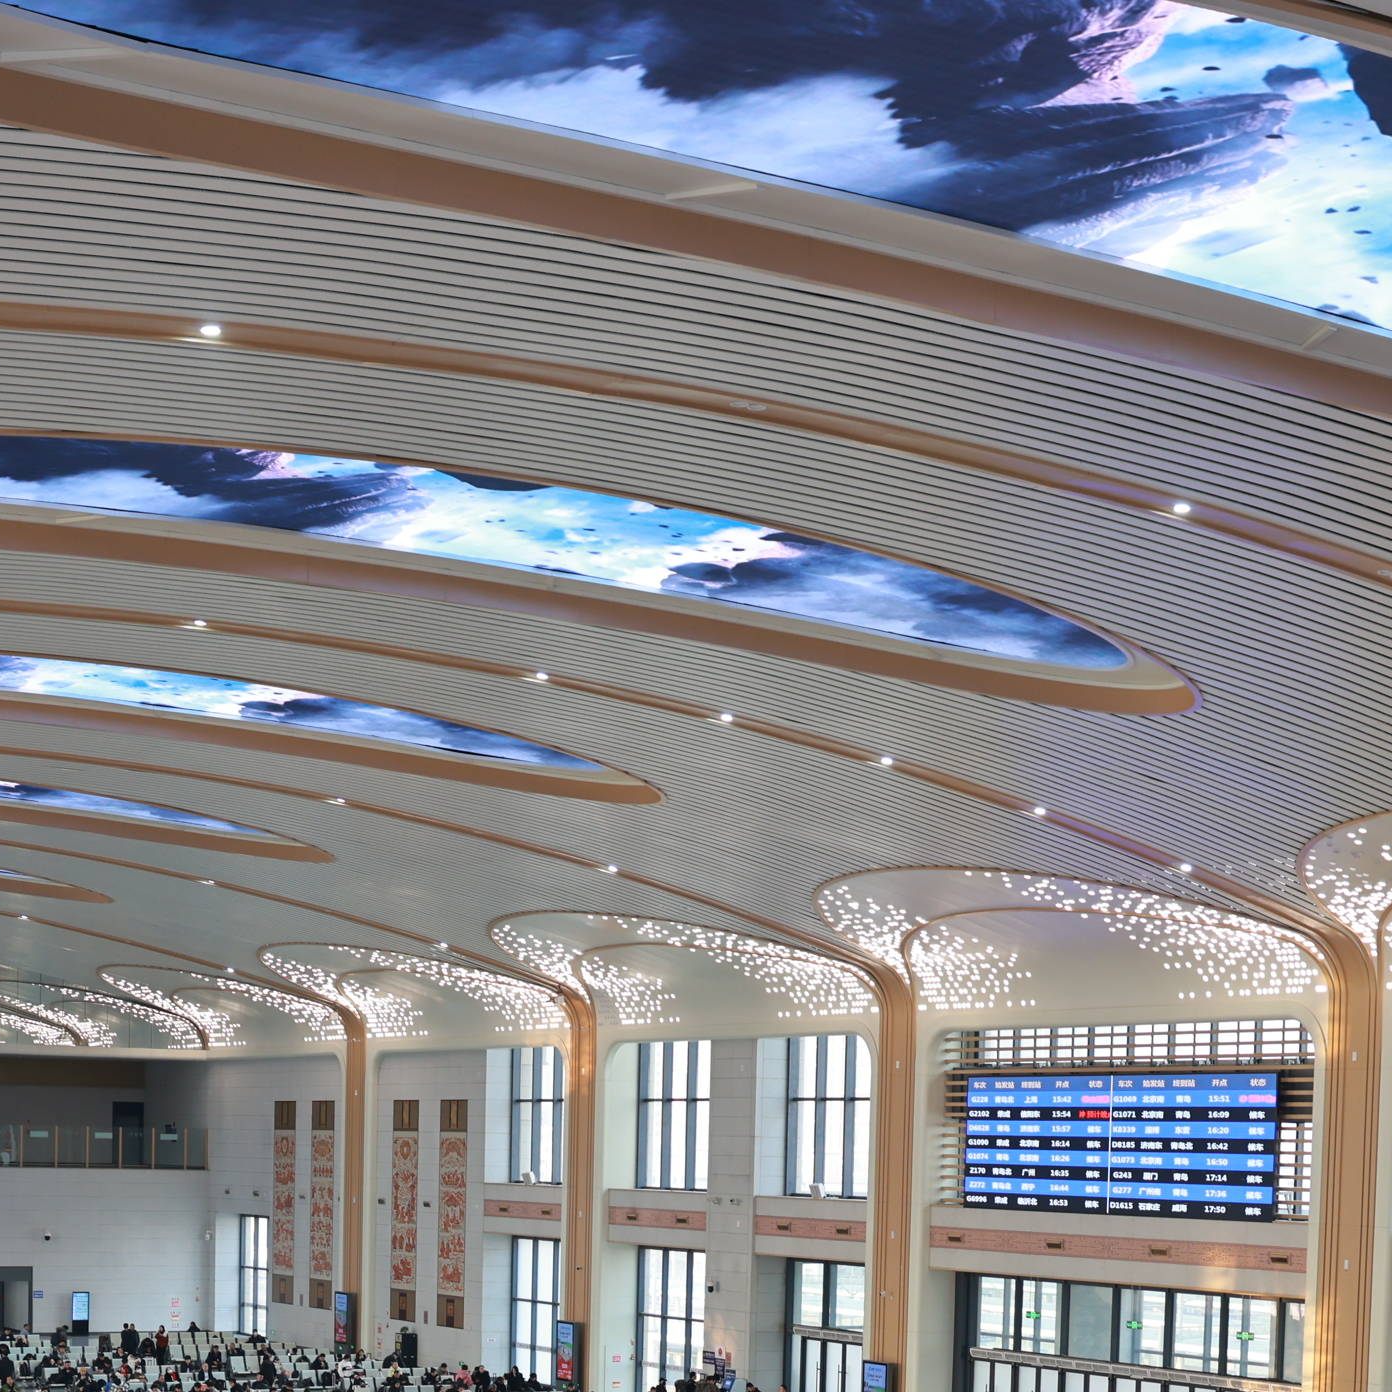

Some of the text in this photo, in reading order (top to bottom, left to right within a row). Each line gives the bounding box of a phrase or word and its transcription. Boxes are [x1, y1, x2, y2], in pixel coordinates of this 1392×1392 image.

[1249, 1111, 1265, 1119] 候车
[1248, 1143, 1264, 1151] 候车
[1248, 1159, 1263, 1167] 候车
[1174, 1173, 1188, 1181] 青岛
[1247, 1175, 1262, 1183] 候车
[1172, 1204, 1187, 1212] 威海
